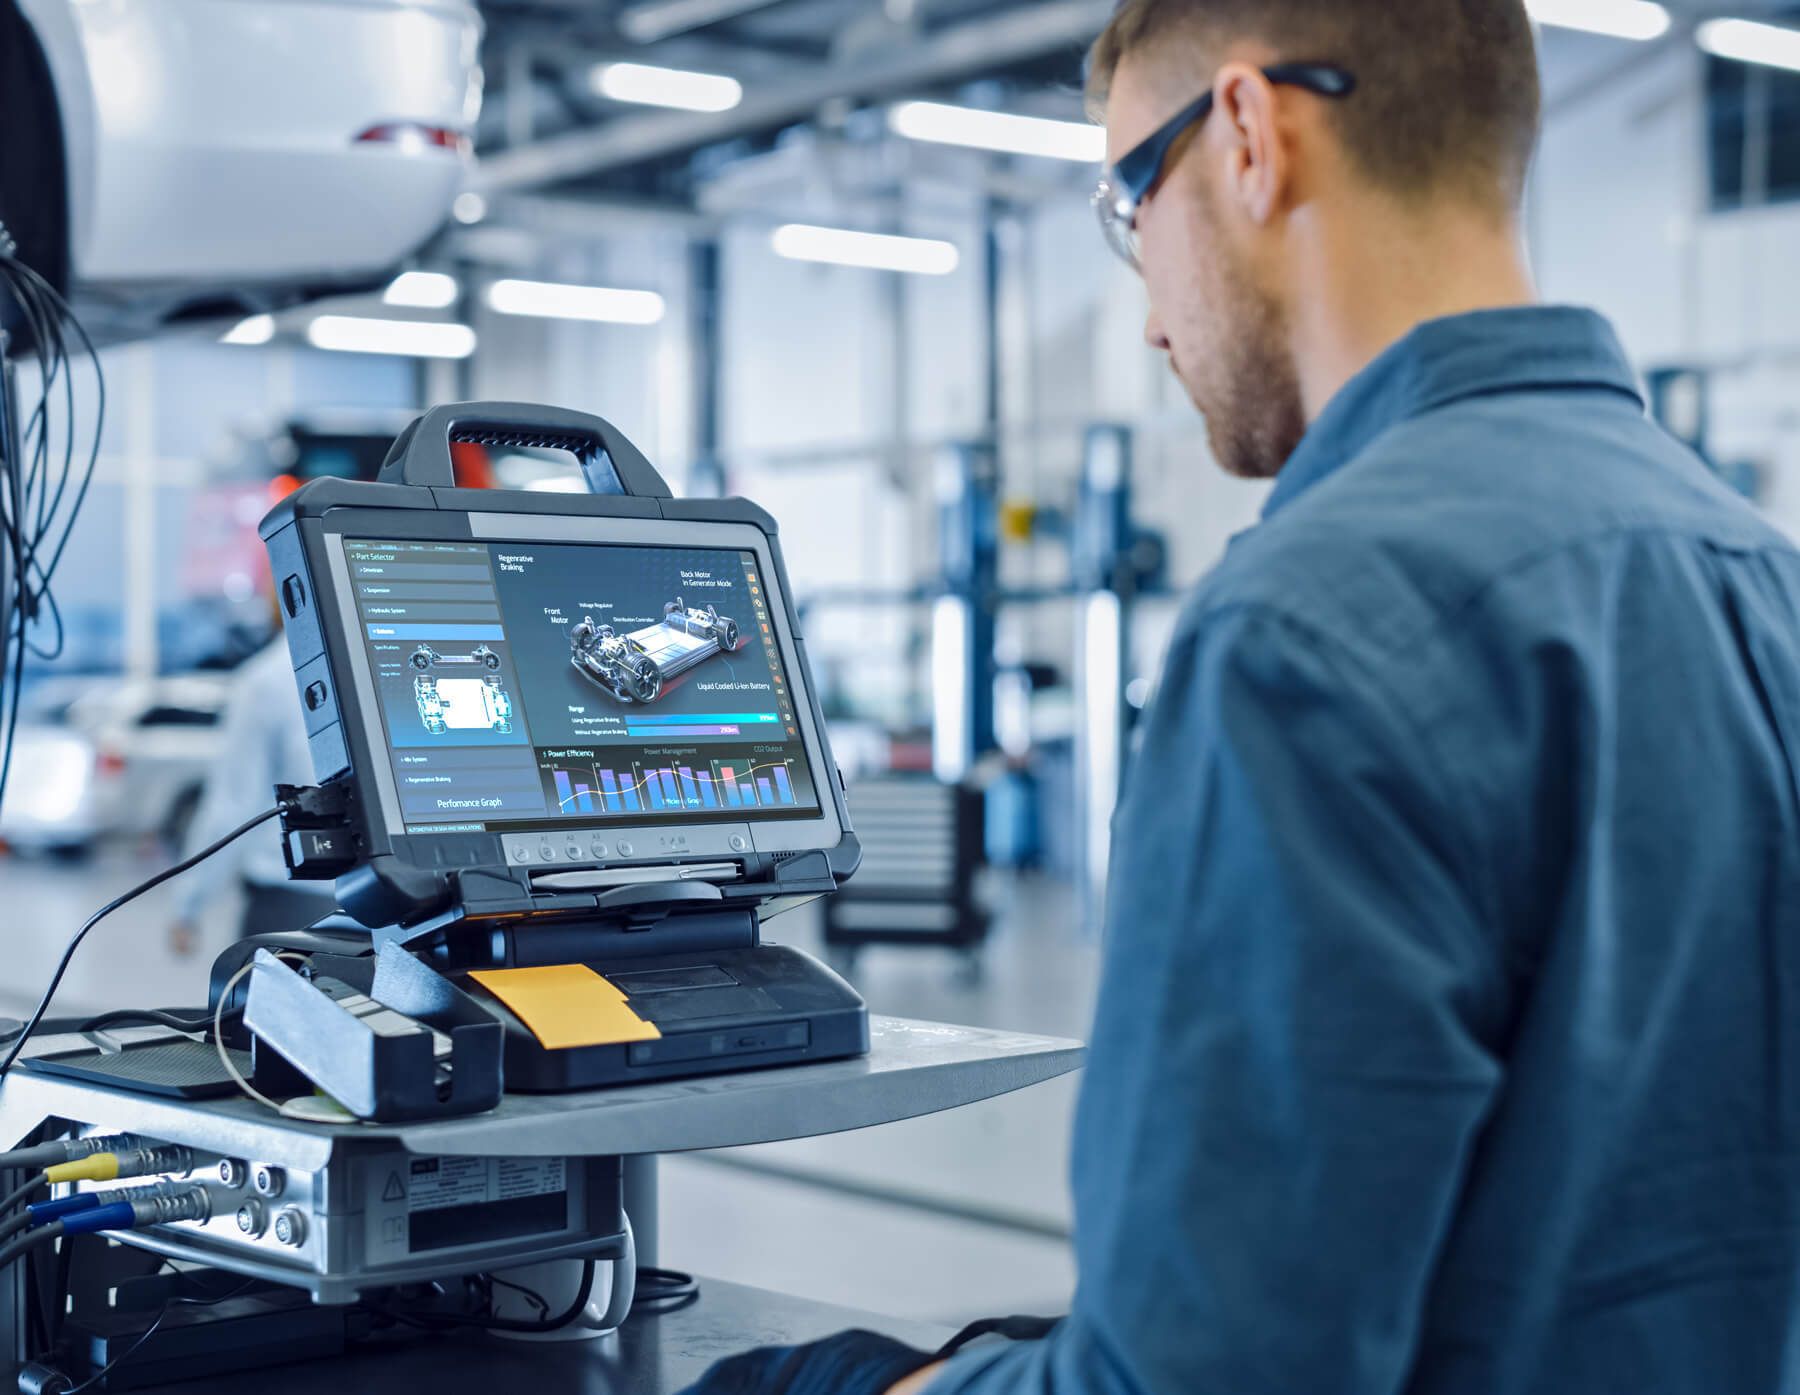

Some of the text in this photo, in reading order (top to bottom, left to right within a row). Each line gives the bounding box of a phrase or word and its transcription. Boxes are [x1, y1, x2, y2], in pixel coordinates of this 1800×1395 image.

[356, 552, 369, 560] Part
[500, 563, 524, 573] Braking
[680, 570, 694, 578] Back
[689, 579, 716, 587] Generator
[544, 607, 561, 615] Front
[697, 682, 714, 692] Liquid
[715, 682, 734, 690] Cooled
[750, 683, 770, 691] Battery
[568, 705, 584, 713] Range
[662, 747, 697, 755] Management
[765, 745, 783, 753] Output
[547, 750, 594, 758] Power Efficiency
[481, 797, 503, 808] Graph
